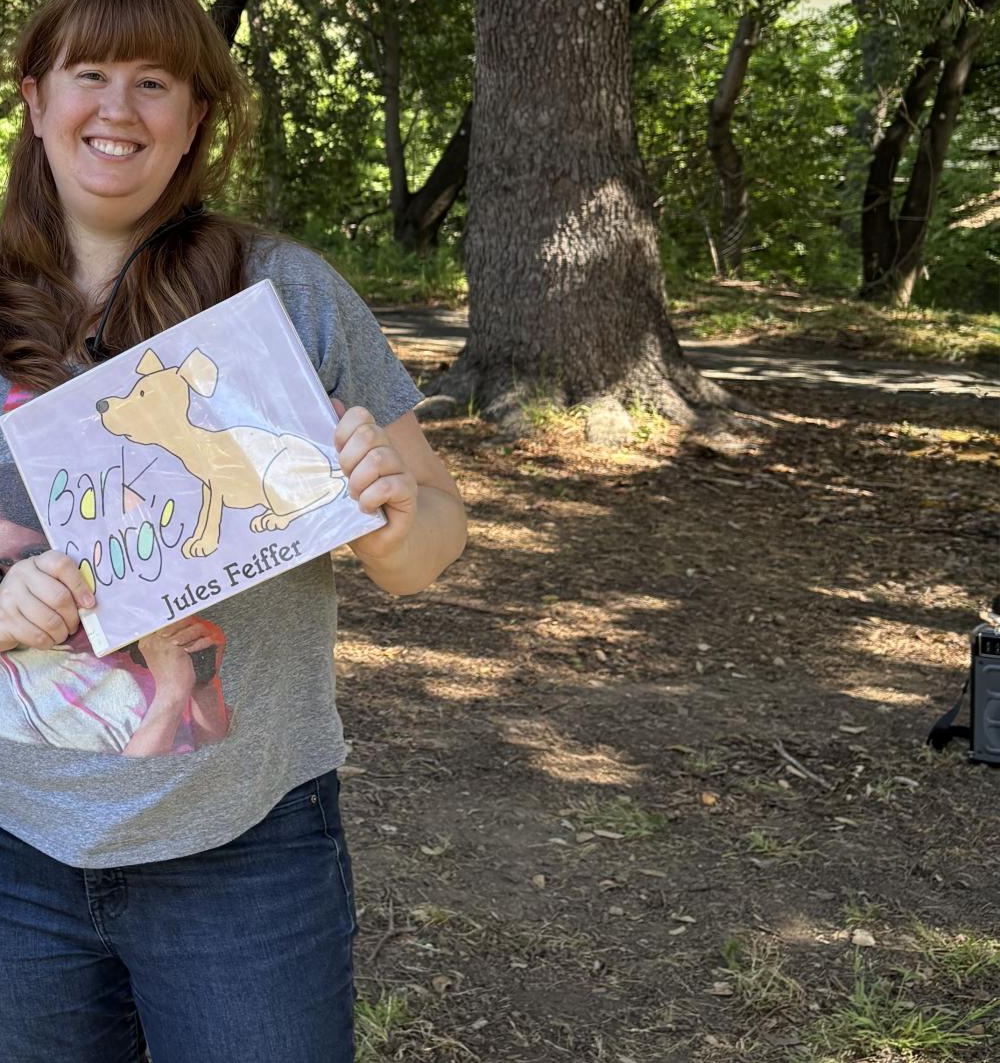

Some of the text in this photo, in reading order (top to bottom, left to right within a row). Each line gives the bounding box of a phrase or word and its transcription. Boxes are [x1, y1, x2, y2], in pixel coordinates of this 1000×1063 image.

[65, 498, 184, 595] George
[161, 538, 304, 621] Jules Feiffer
